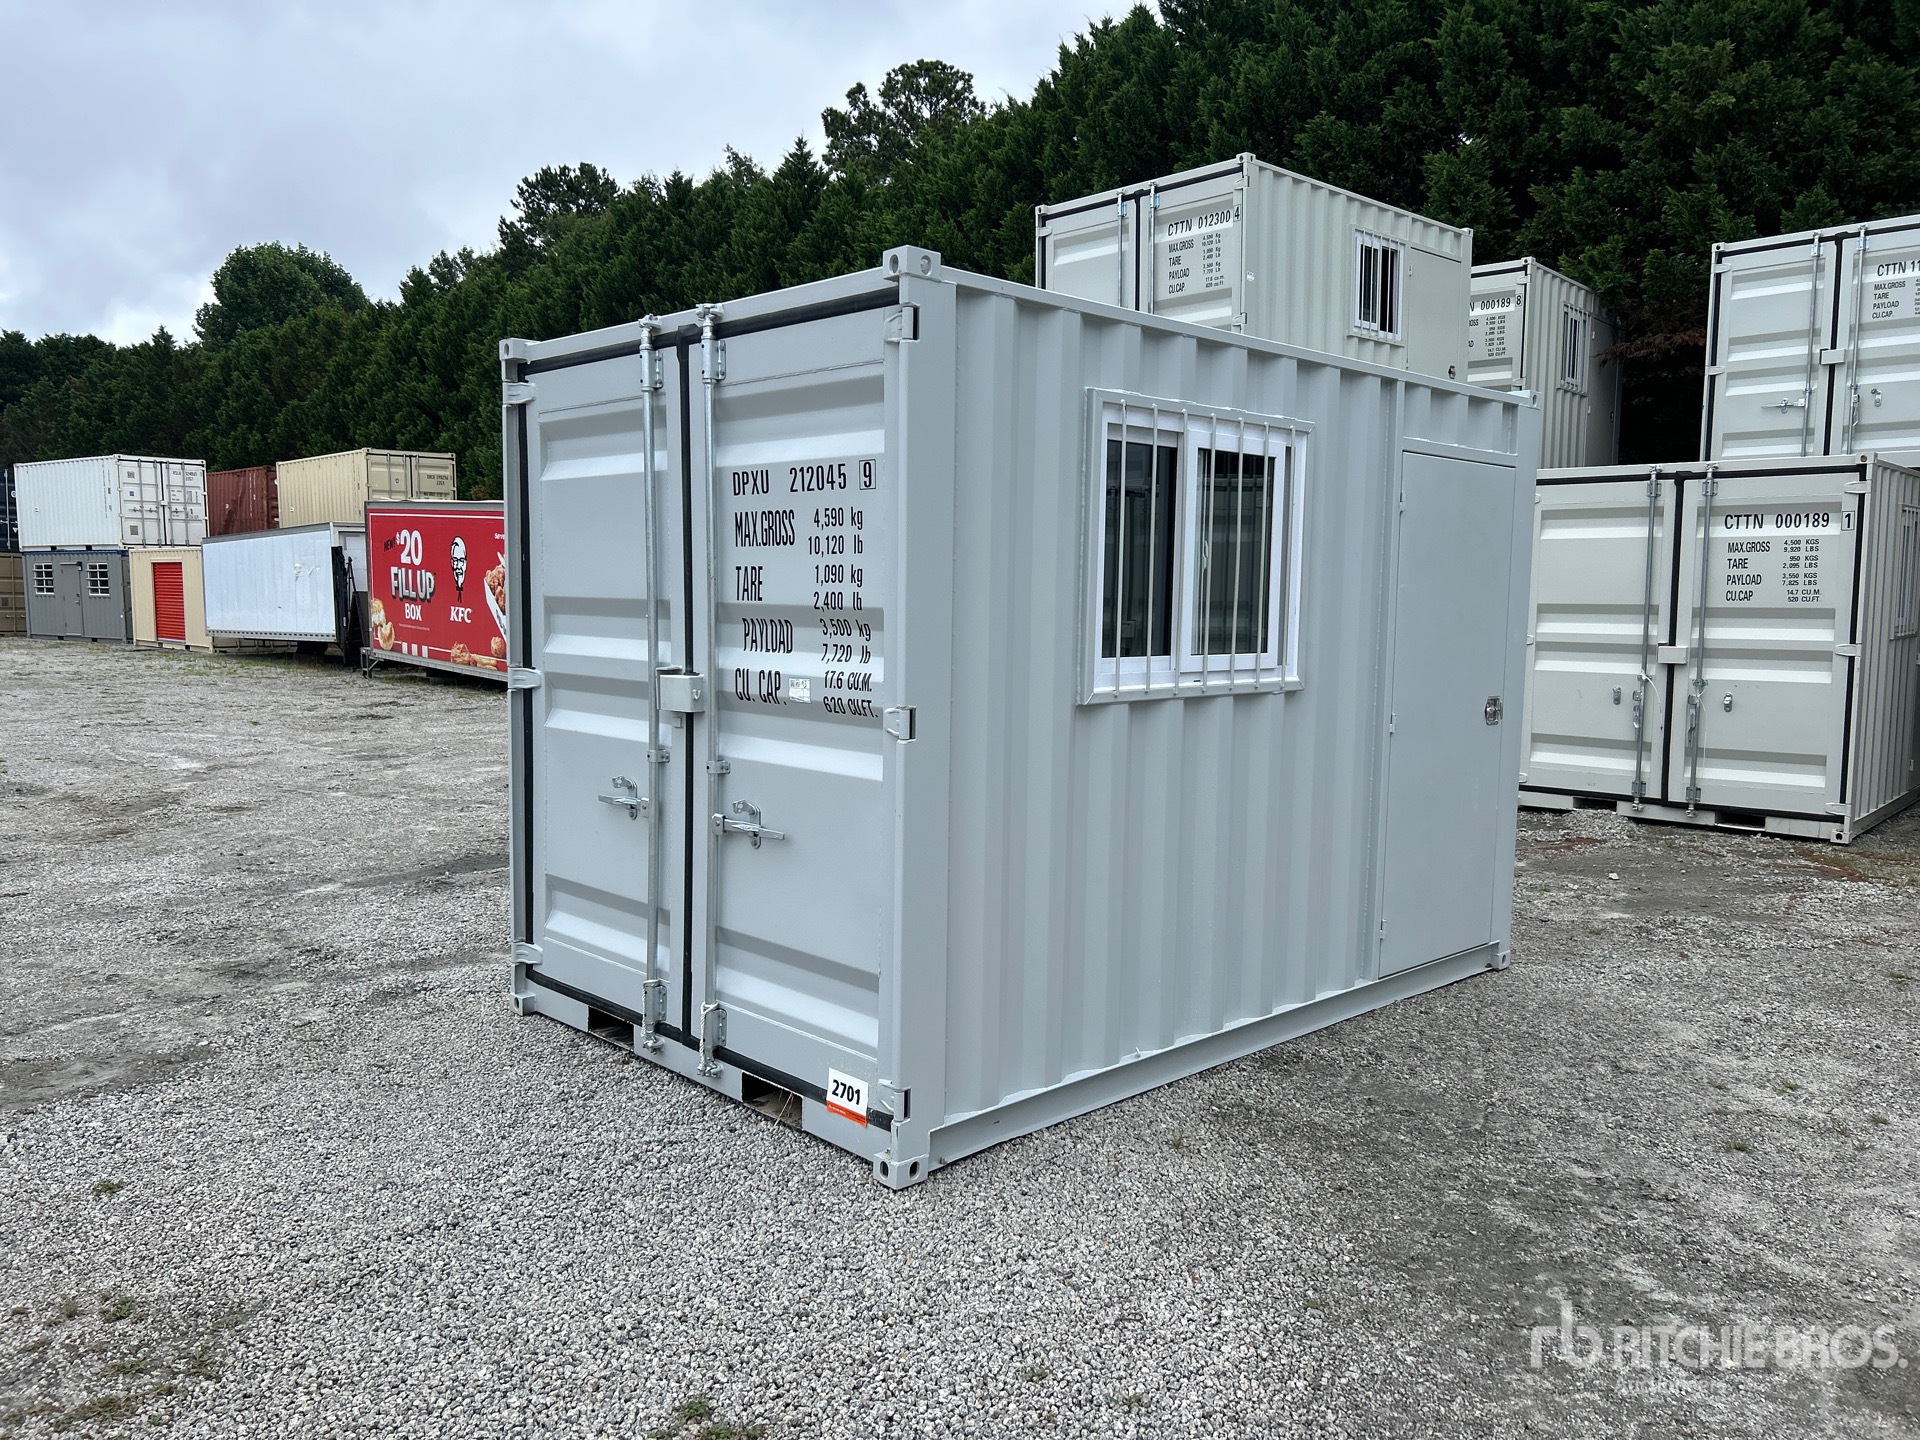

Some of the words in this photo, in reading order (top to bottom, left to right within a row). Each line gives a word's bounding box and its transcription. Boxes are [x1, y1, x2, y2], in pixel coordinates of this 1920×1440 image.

[1168, 218, 1192, 236] CTTN
[1198, 209, 1231, 229] 012300
[1168, 239, 1194, 254] MAX.GROSS
[1169, 255, 1182, 267] TARE
[1877, 261, 1906, 277] CTTN
[1169, 268, 1190, 281] PAYLOAD
[1481, 297, 1510, 310] 000189
[1873, 300, 1900, 310] PAYLOAD
[1874, 292, 1889, 300] TARE
[733, 469, 769, 496] DPXU
[789, 463, 847, 492] 212045
[862, 460, 874, 489] 9
[735, 509, 795, 547] MAX.GROSS
[813, 507, 844, 530] 4,590
[851, 507, 863, 530] kg
[1724, 513, 1764, 529] CTTN
[1776, 512, 1829, 529] 000189
[396, 529, 423, 566] $20
[808, 535, 844, 558] 10,120
[853, 534, 863, 554] lb
[1727, 540, 1770, 553] MAX.GROSS
[1727, 558, 1748, 569] TARE
[390, 566, 417, 601] FILL
[416, 569, 435, 602] UP
[736, 565, 763, 602] TARE
[815, 564, 844, 586] 1,090
[851, 564, 863, 588] kg
[1726, 574, 1762, 586] PAYLOAD
[814, 592, 843, 613] 2,400
[852, 592, 863, 611] lb
[1726, 590, 1753, 601] CU.CAP
[405, 603, 422, 621] BOX
[450, 606, 472, 623] KFC
[742, 618, 793, 654] PAYLOAD
[820, 618, 851, 639] 3,500
[855, 619, 871, 642] kg
[821, 644, 851, 665] 7,720
[860, 645, 871, 664] lb
[824, 670, 843, 690] 17.6
[847, 671, 872, 692] CU.M.
[823, 696, 845, 714] 620
[847, 698, 879, 719] CU.FT.
[832, 1079, 861, 1105] 2701
